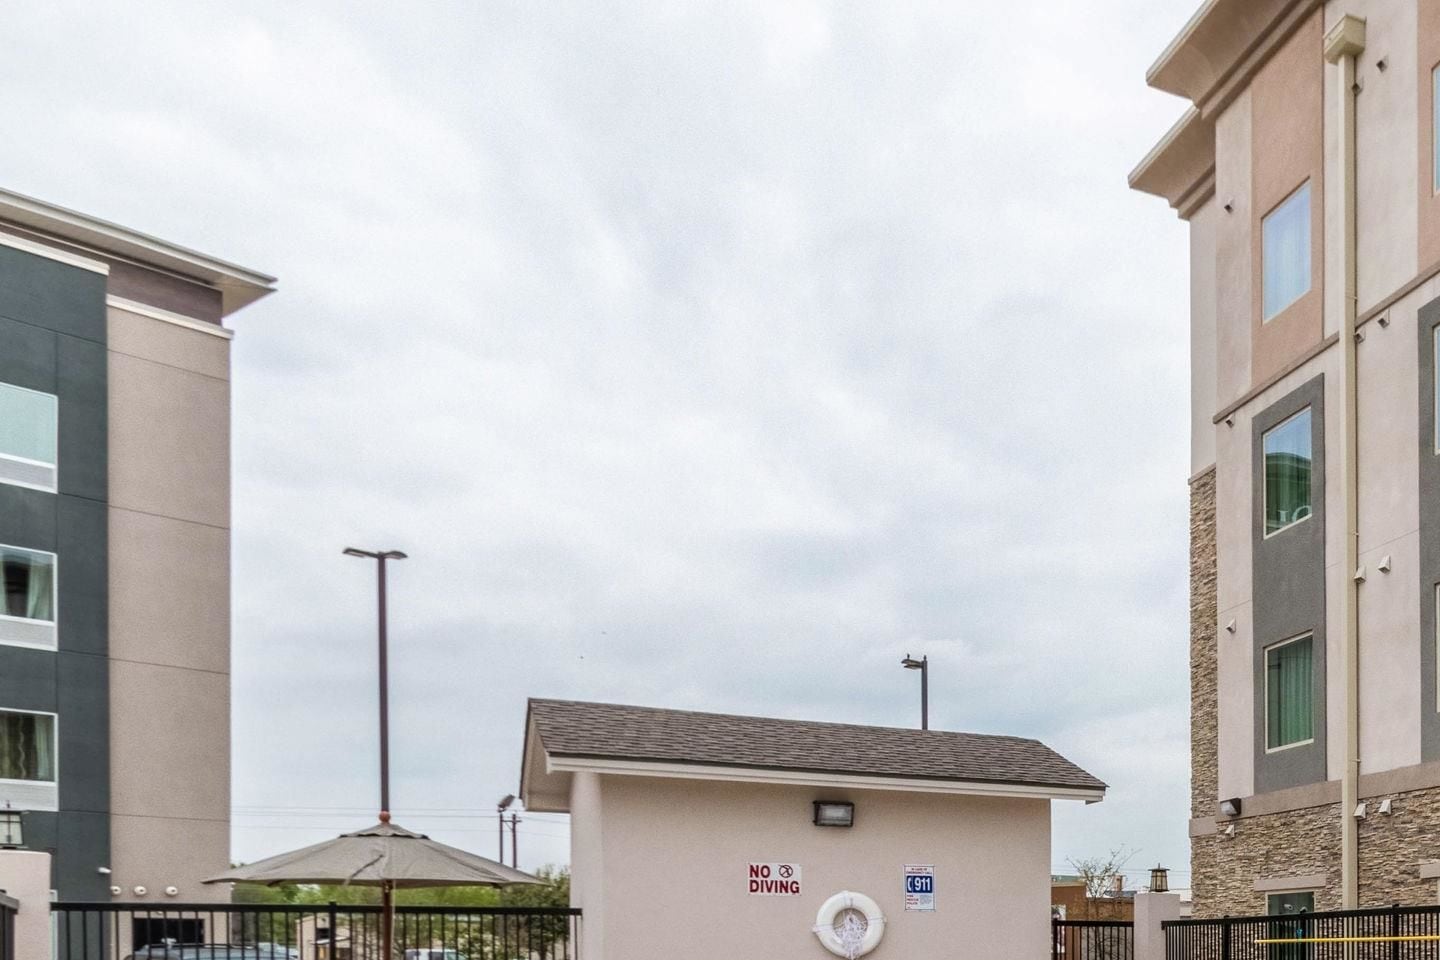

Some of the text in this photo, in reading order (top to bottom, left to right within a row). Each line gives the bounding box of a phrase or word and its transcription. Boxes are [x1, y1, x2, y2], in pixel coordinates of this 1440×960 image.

[750, 864, 770, 878] NO
[750, 880, 800, 894] DIVING
[914, 877, 931, 891] 911
